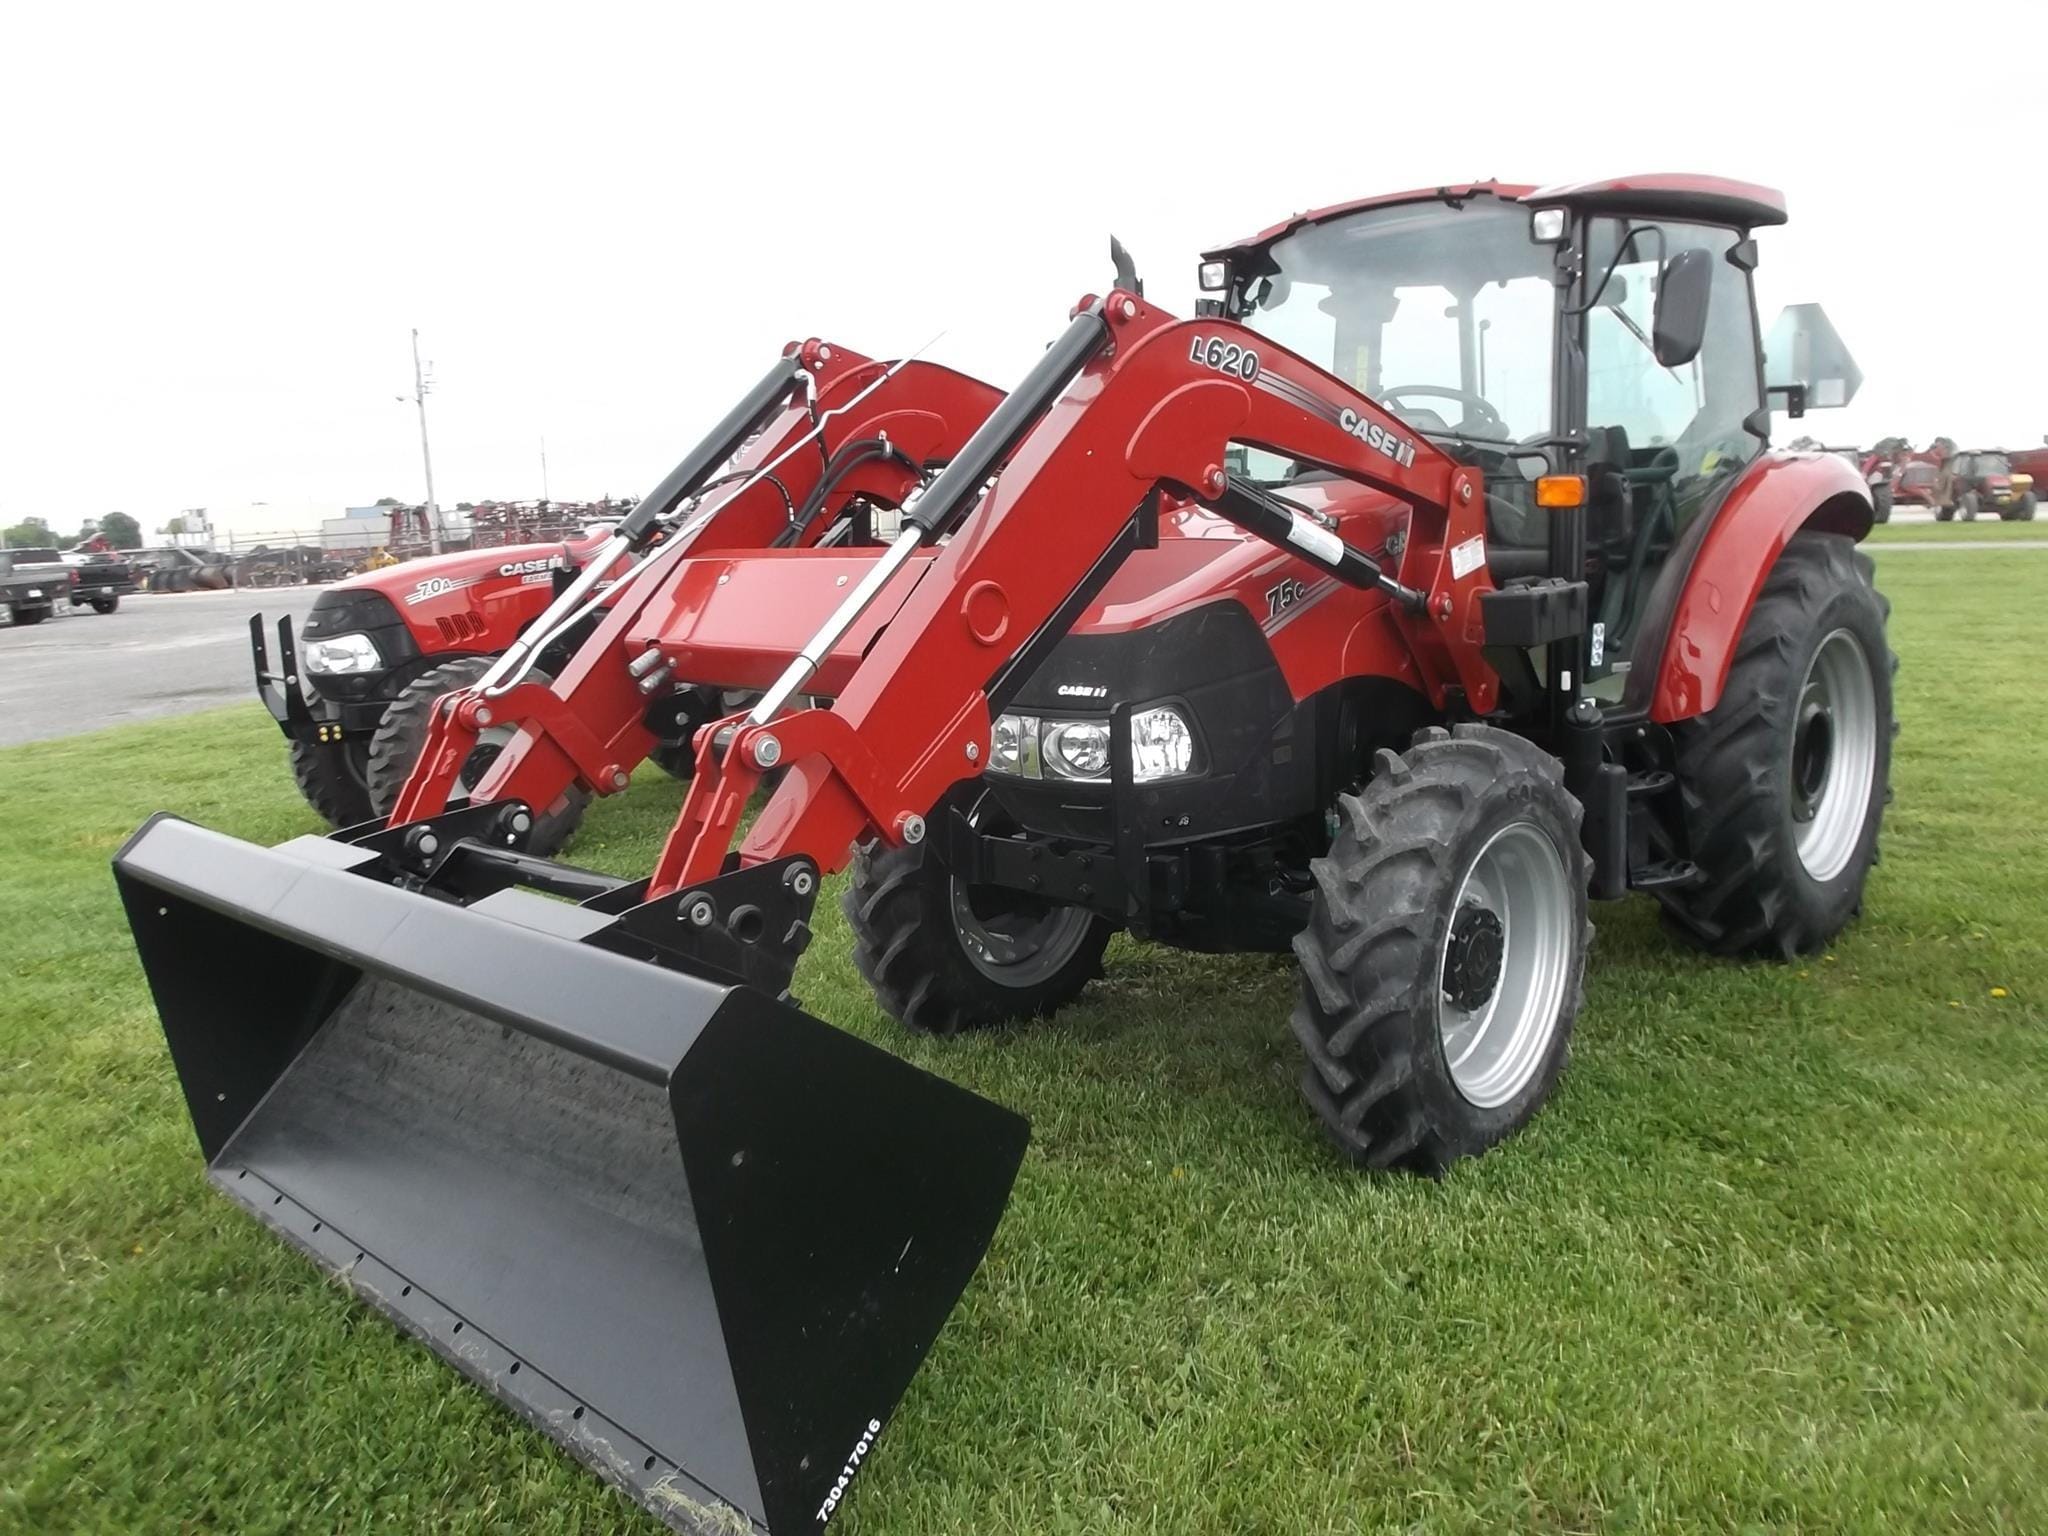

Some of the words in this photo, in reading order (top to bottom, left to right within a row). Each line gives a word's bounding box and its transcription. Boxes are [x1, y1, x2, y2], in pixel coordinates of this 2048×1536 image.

[1189, 335, 1260, 383] L620
[1339, 407, 1398, 458] CASE
[499, 558, 547, 577] CASE
[1057, 684, 1094, 697] CASE
[815, 1418, 882, 1523] 730417016
